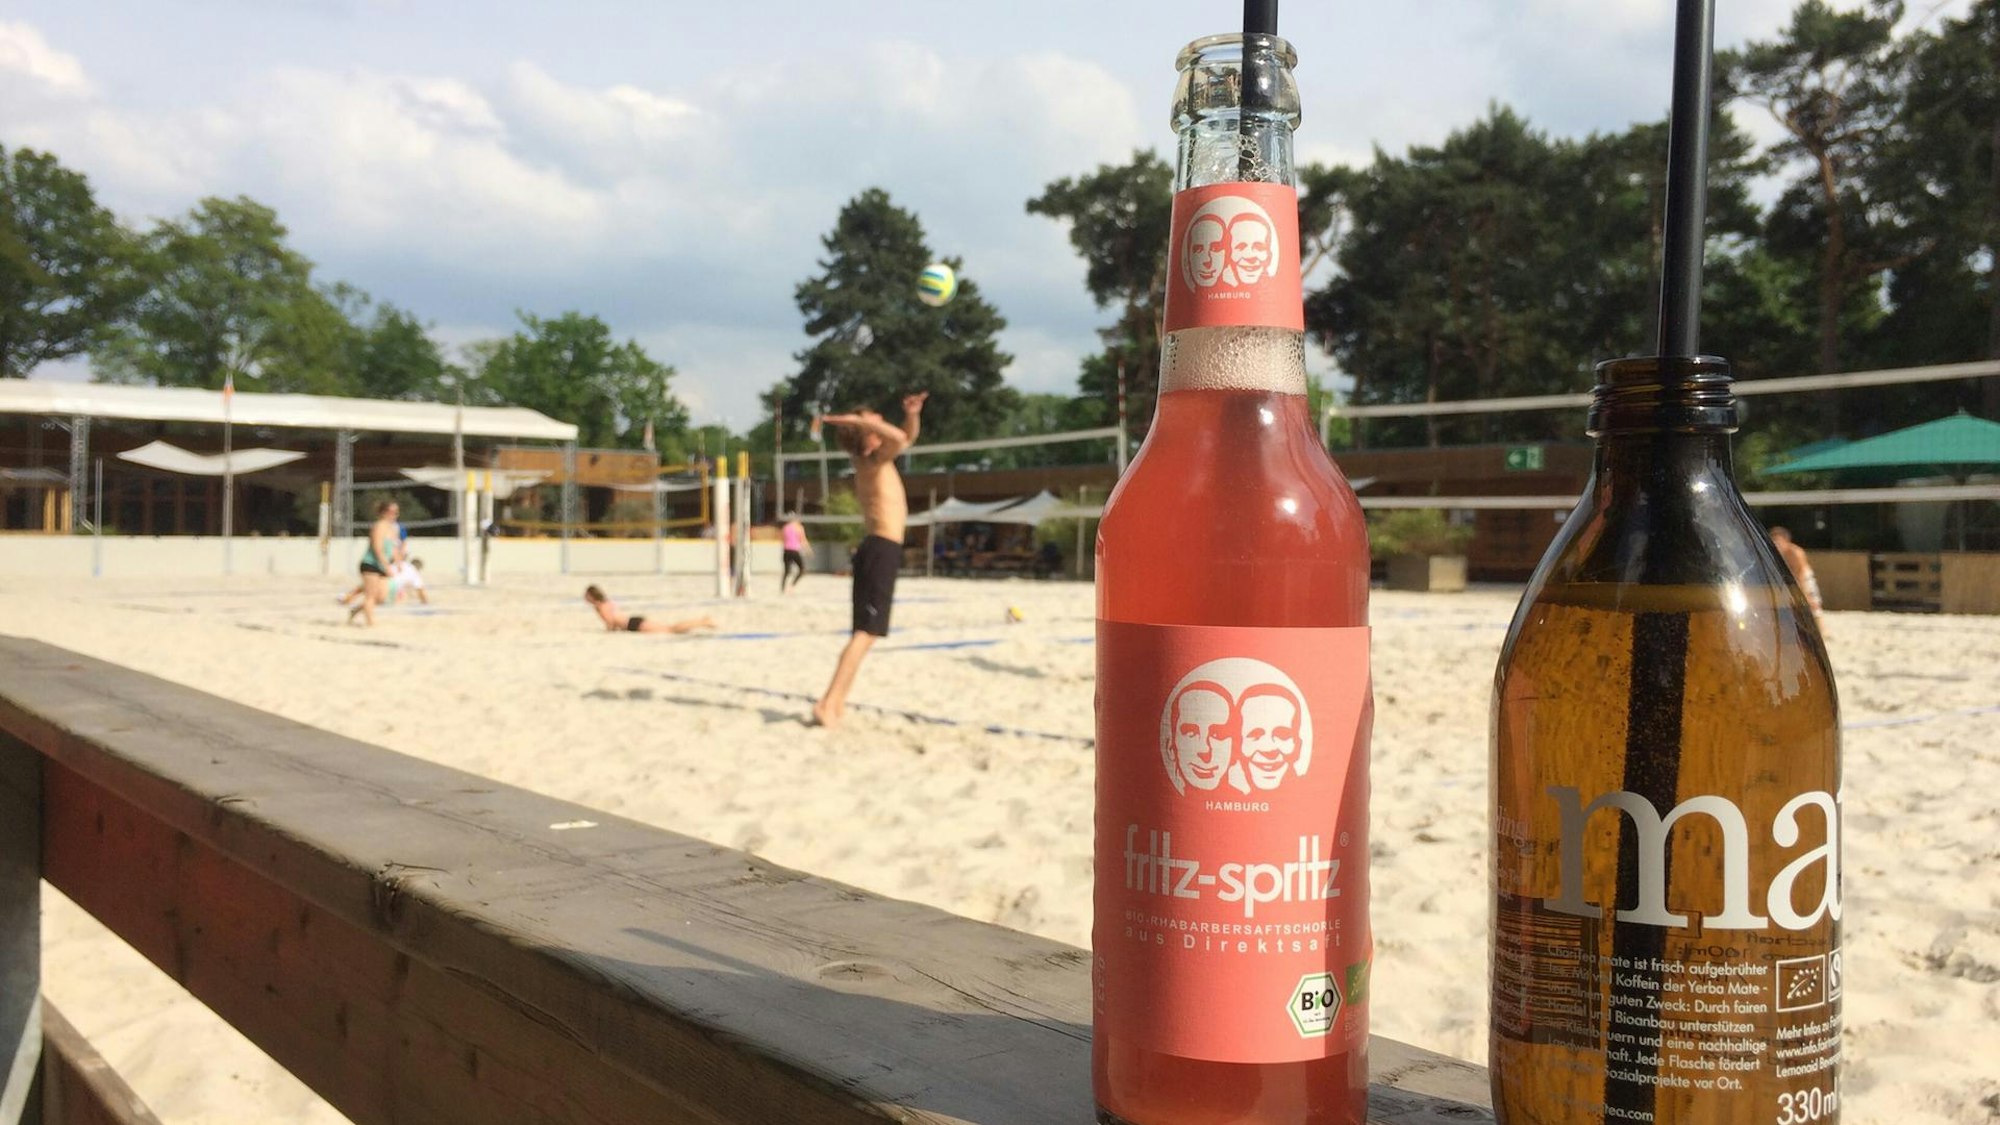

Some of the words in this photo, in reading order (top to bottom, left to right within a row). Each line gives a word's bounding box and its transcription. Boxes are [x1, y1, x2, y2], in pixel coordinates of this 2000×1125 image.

[1207, 291, 1251, 301] HAMBURG
[1205, 800, 1270, 813] HAMBURG
[1543, 784, 1842, 931] ma
[1125, 925, 1165, 945] aus
[1183, 933, 1341, 954] Direktsaft
[1633, 956, 1647, 970] ist
[1650, 957, 1685, 974] frisch
[1689, 960, 1768, 978] aufgebrühter
[1615, 973, 1660, 991] Koffein
[1663, 977, 1686, 992] der
[1687, 978, 1724, 995] Yerba
[1727, 980, 1760, 995] Mate
[1608, 994, 1643, 1009] guten
[1646, 995, 1691, 1012] Zweck:
[1694, 1000, 1730, 1014] Durch
[1733, 1000, 1768, 1014] fairen
[1615, 1010, 1676, 1031] Bioanbau
[1679, 1019, 1754, 1033] unterstützen
[1776, 1024, 1802, 1040] Mehr
[1803, 1020, 1821, 1037] Infos
[1566, 1021, 1636, 1044] Kleinbuern
[1639, 1034, 1664, 1048] und
[1667, 1036, 1694, 1050] eine
[1698, 1038, 1768, 1054] nachhaltige
[1635, 1051, 1665, 1067] Jede
[1669, 1055, 1715, 1071] Flasche
[1718, 1056, 1760, 1071] fördert
[1776, 1058, 1819, 1078] Lemonaid
[1693, 1078, 1714, 1089] vor
[1716, 1077, 1743, 1091] Ort.
